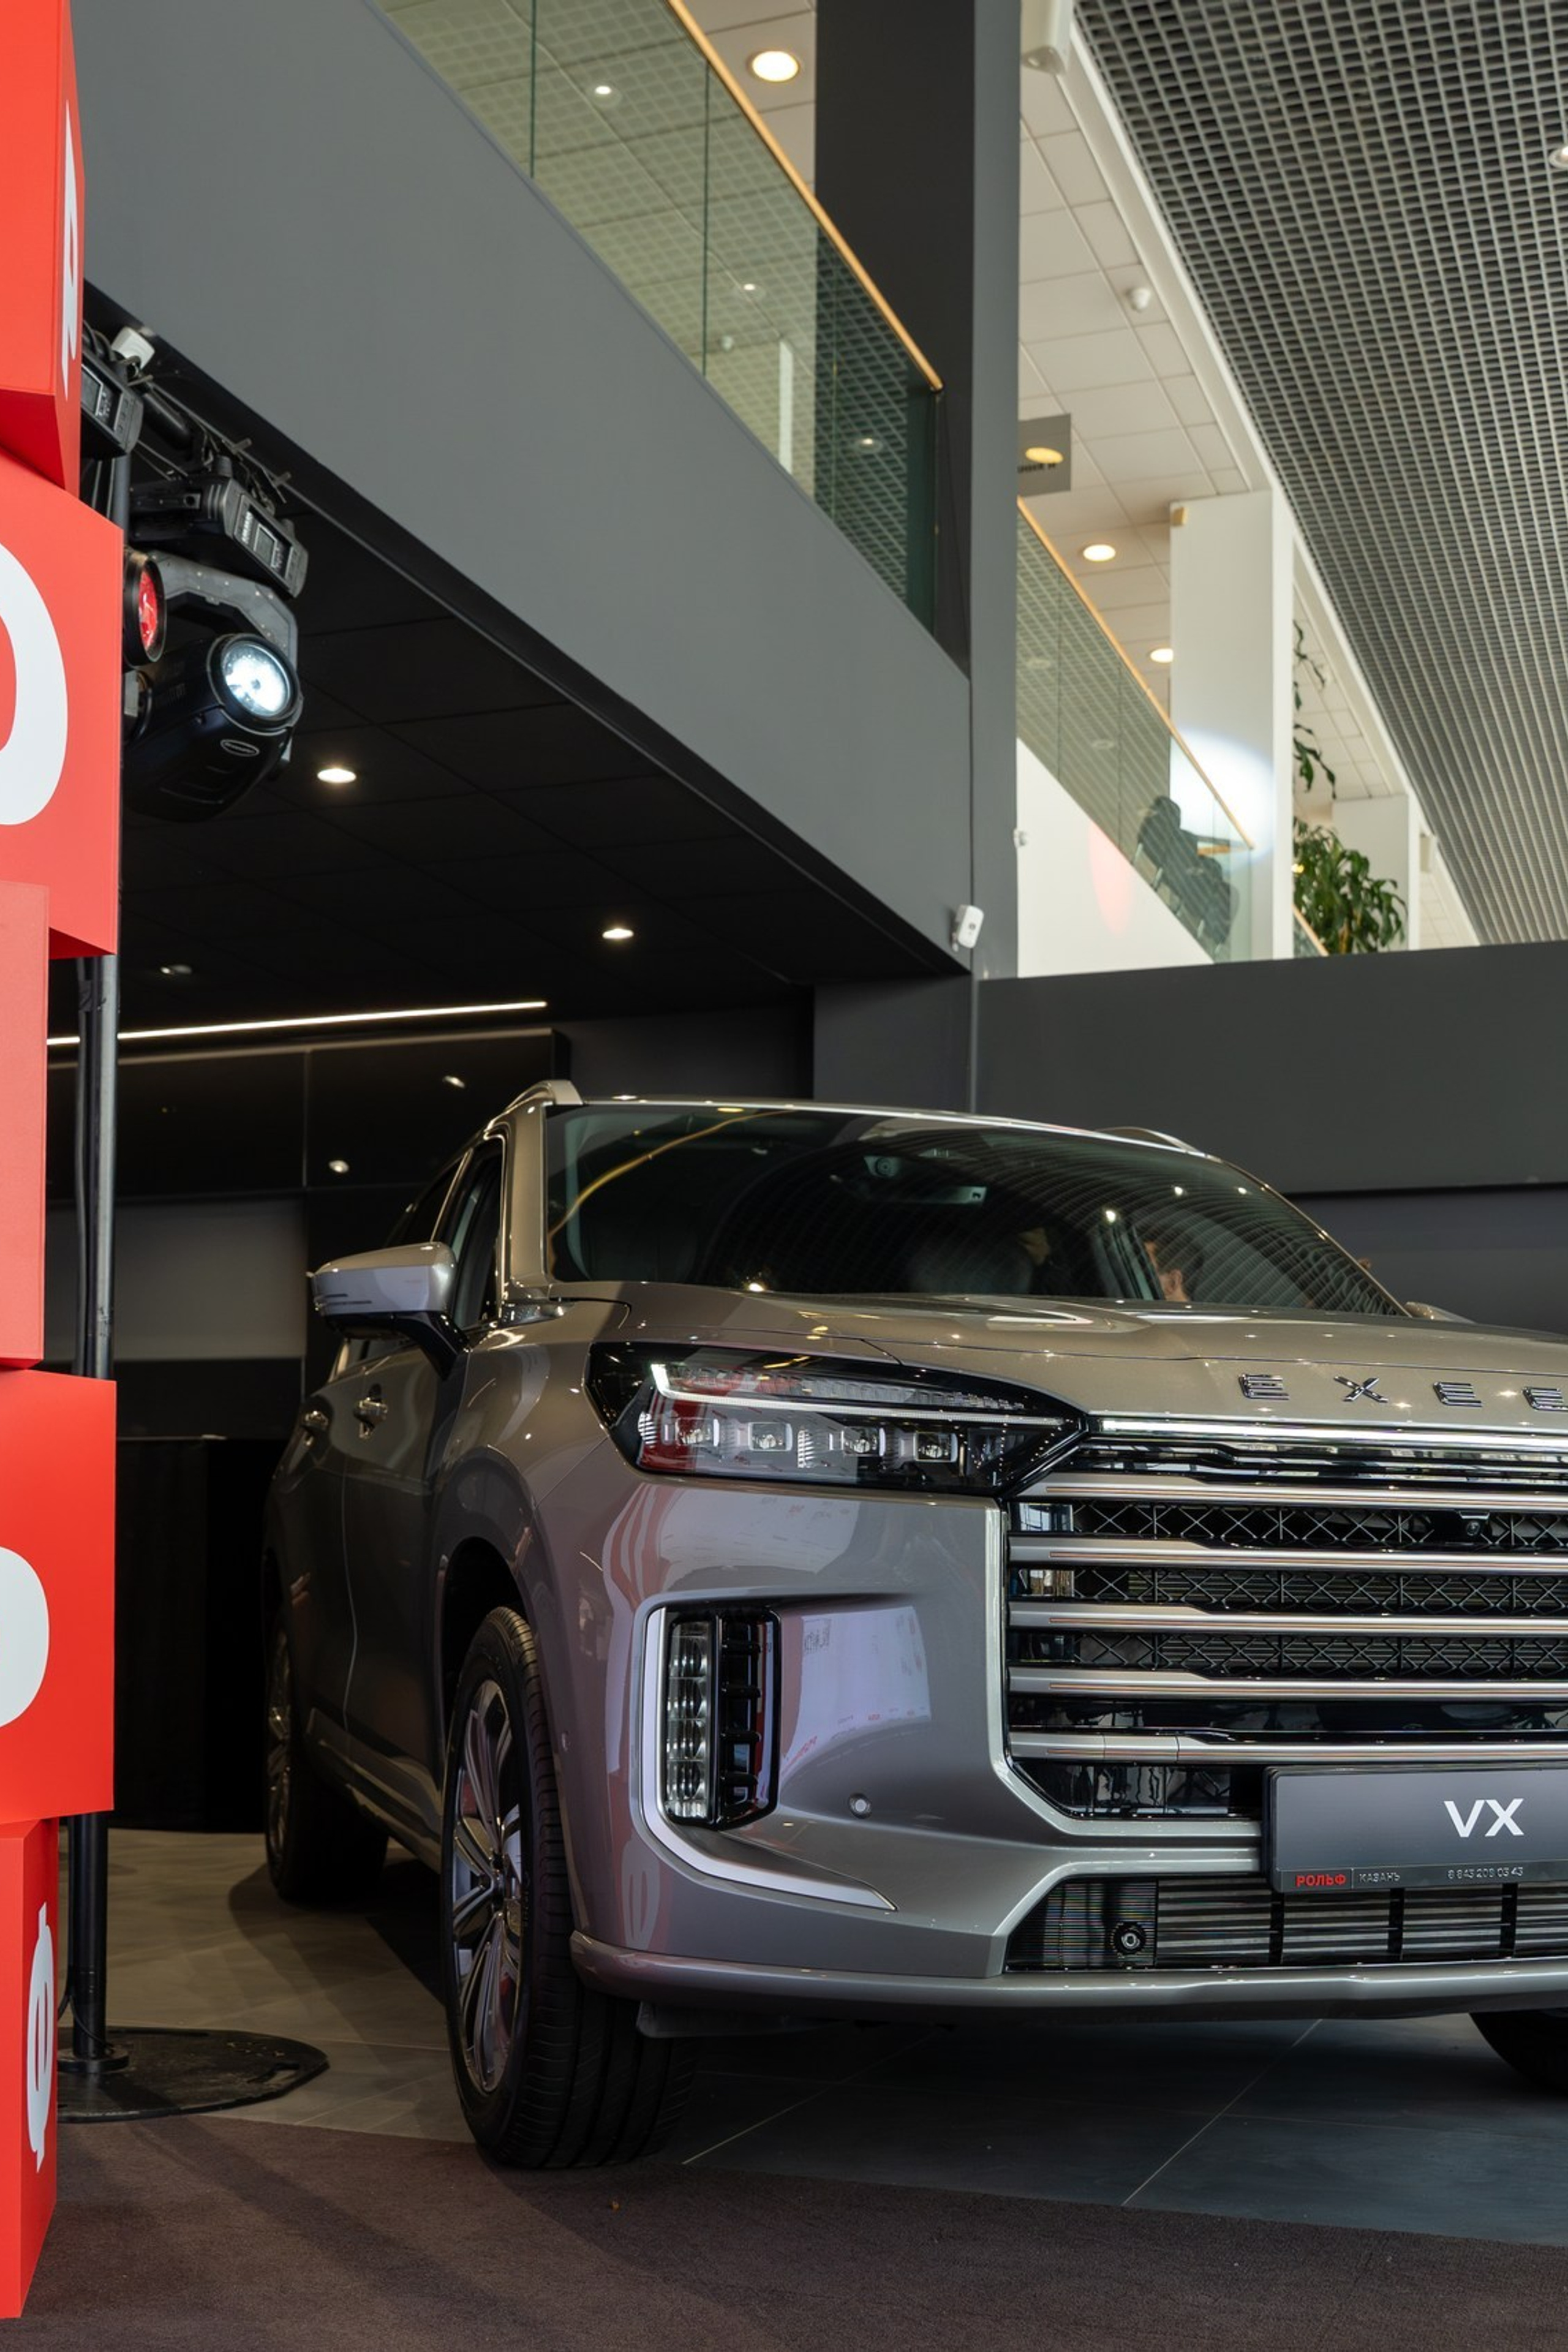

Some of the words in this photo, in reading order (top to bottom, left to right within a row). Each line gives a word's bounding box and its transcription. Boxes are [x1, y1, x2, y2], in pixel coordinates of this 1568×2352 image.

[1444, 1798, 1525, 1838] VX
[1296, 1874, 1346, 1887] РОЛЬФ
[1359, 1872, 1400, 1882] КАЗАНЬ
